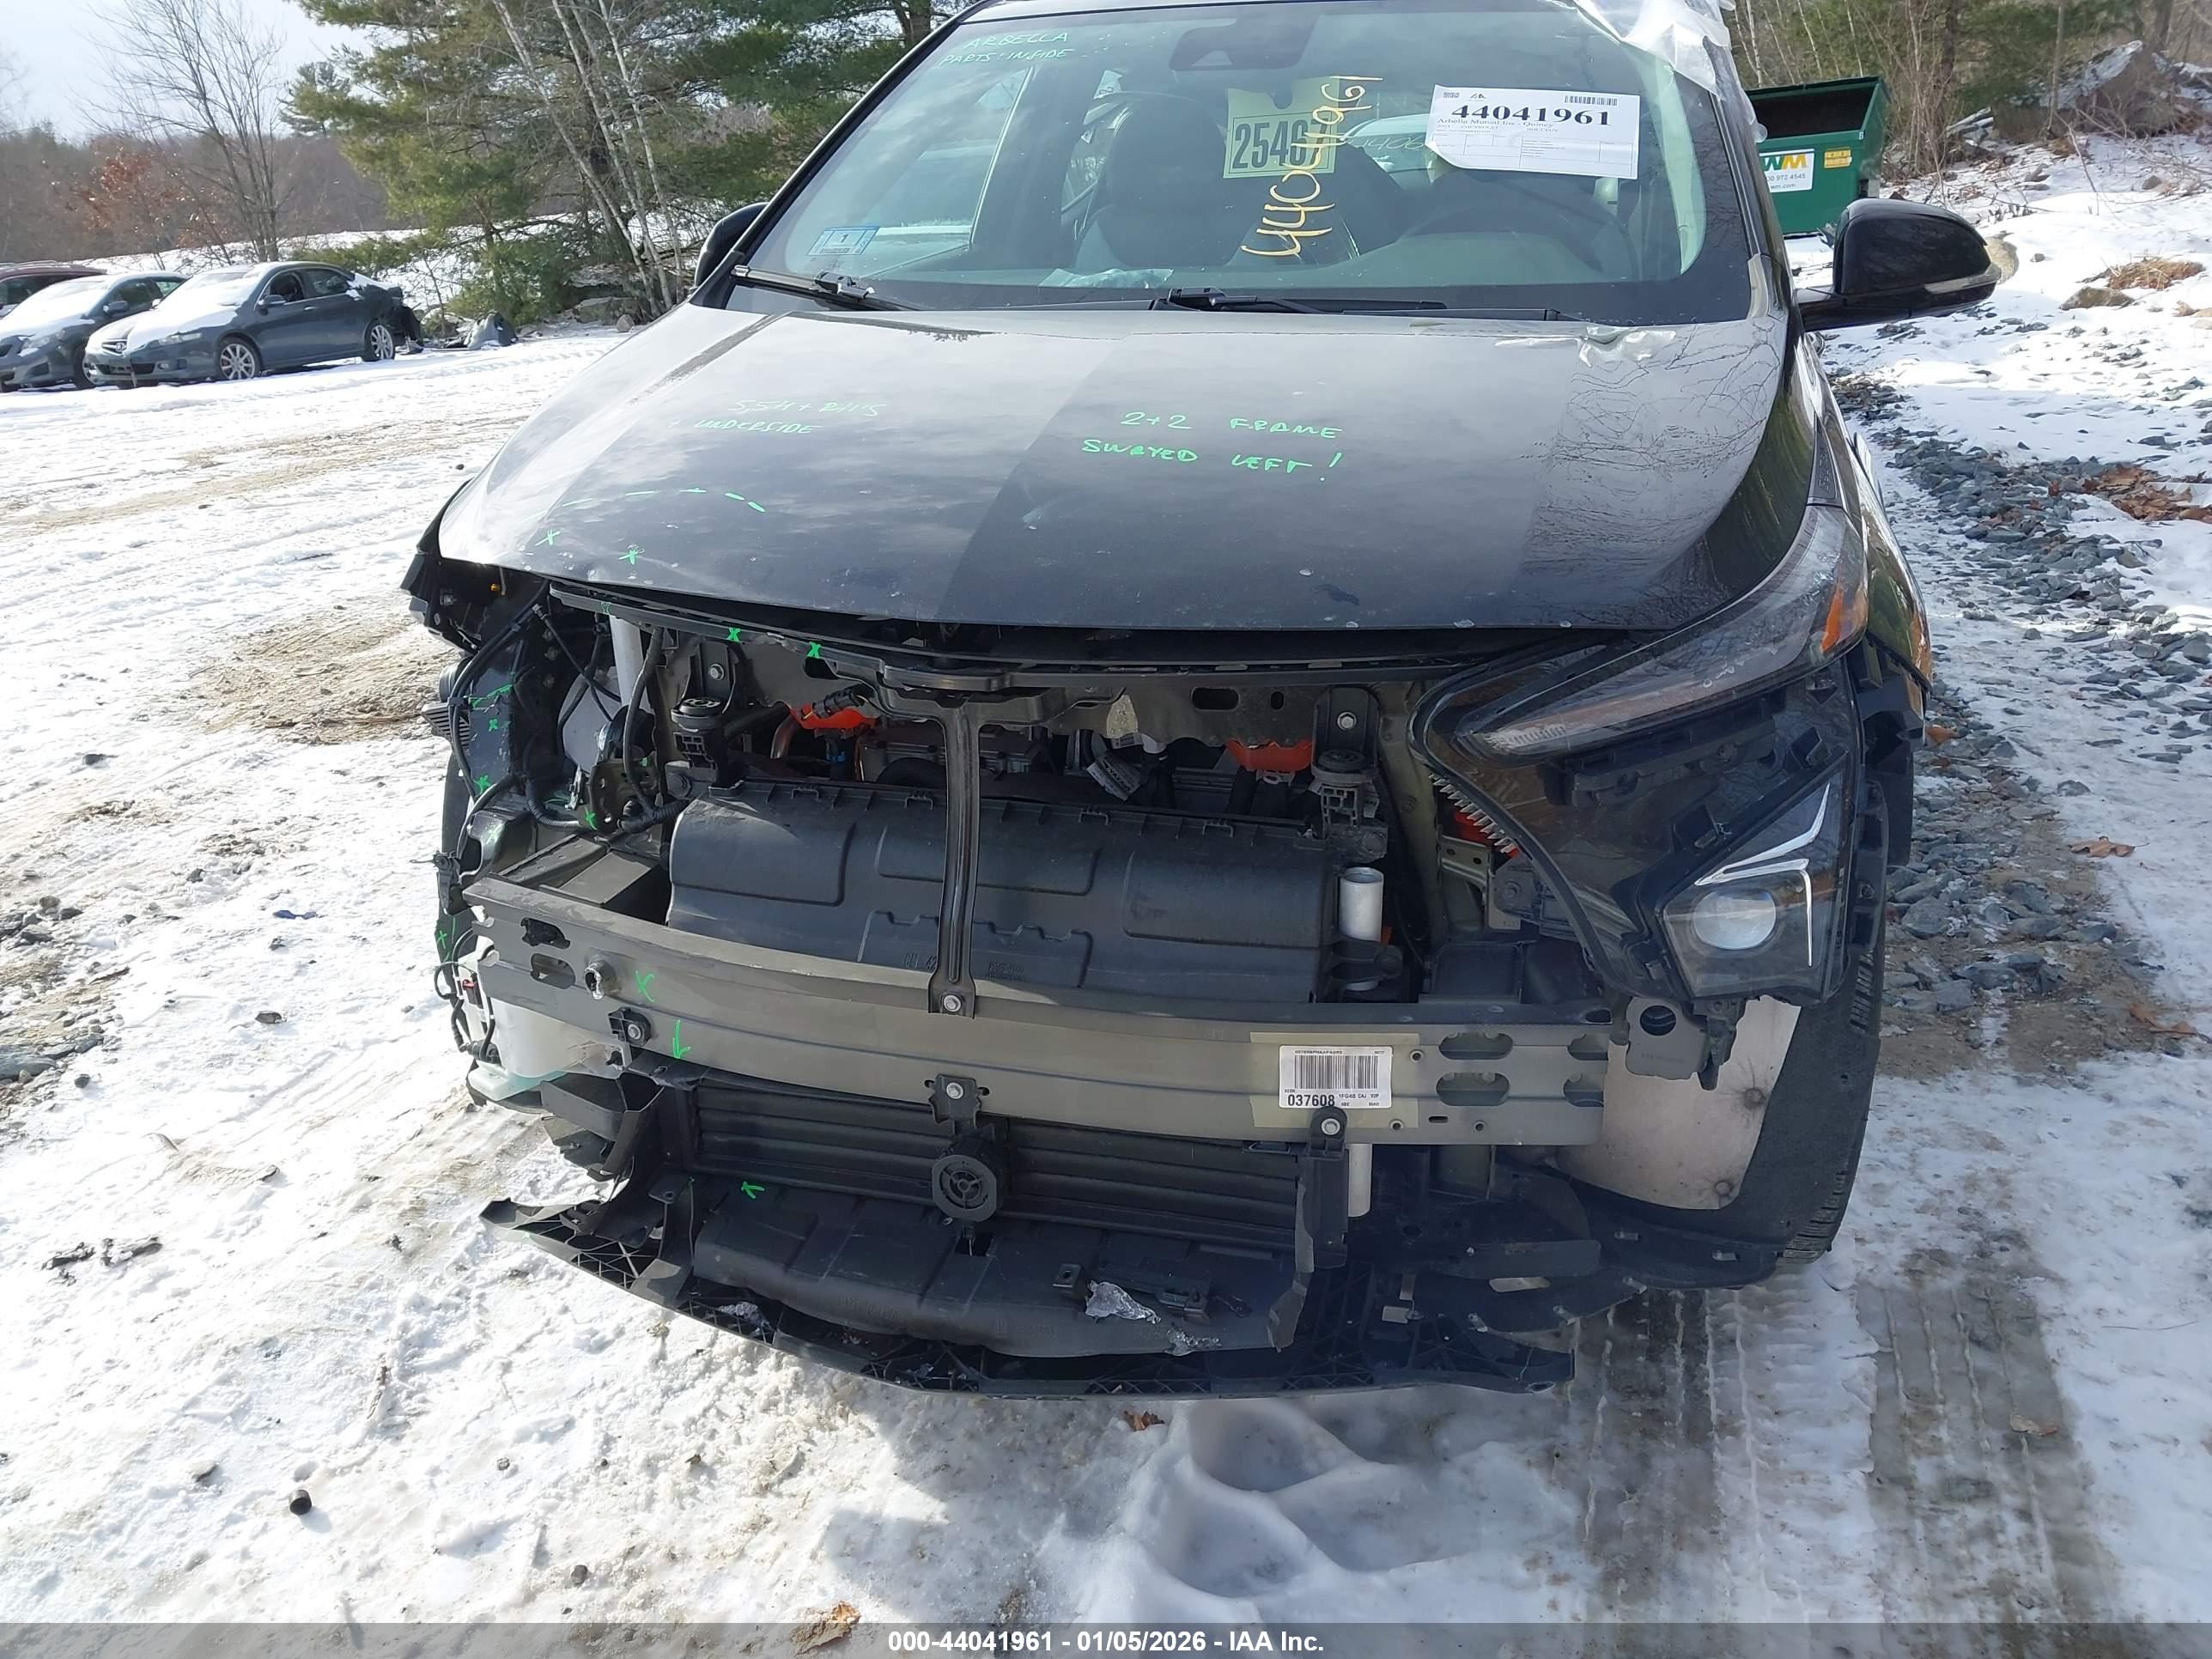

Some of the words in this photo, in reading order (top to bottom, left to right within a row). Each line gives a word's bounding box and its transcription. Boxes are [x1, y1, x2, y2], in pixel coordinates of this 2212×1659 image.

[963, 32, 1068, 50] ARBELLA
[1006, 48, 1075, 61] INSIDE
[1450, 104, 1613, 126] 44041961
[1231, 118, 1329, 169] 25467
[1240, 75, 1384, 257] 44041961
[694, 418, 823, 434] UNDERSIDE
[1229, 417, 1343, 439] FRAME
[1081, 439, 1199, 462] SWAYED
[1287, 1093, 1335, 1107] 037608
